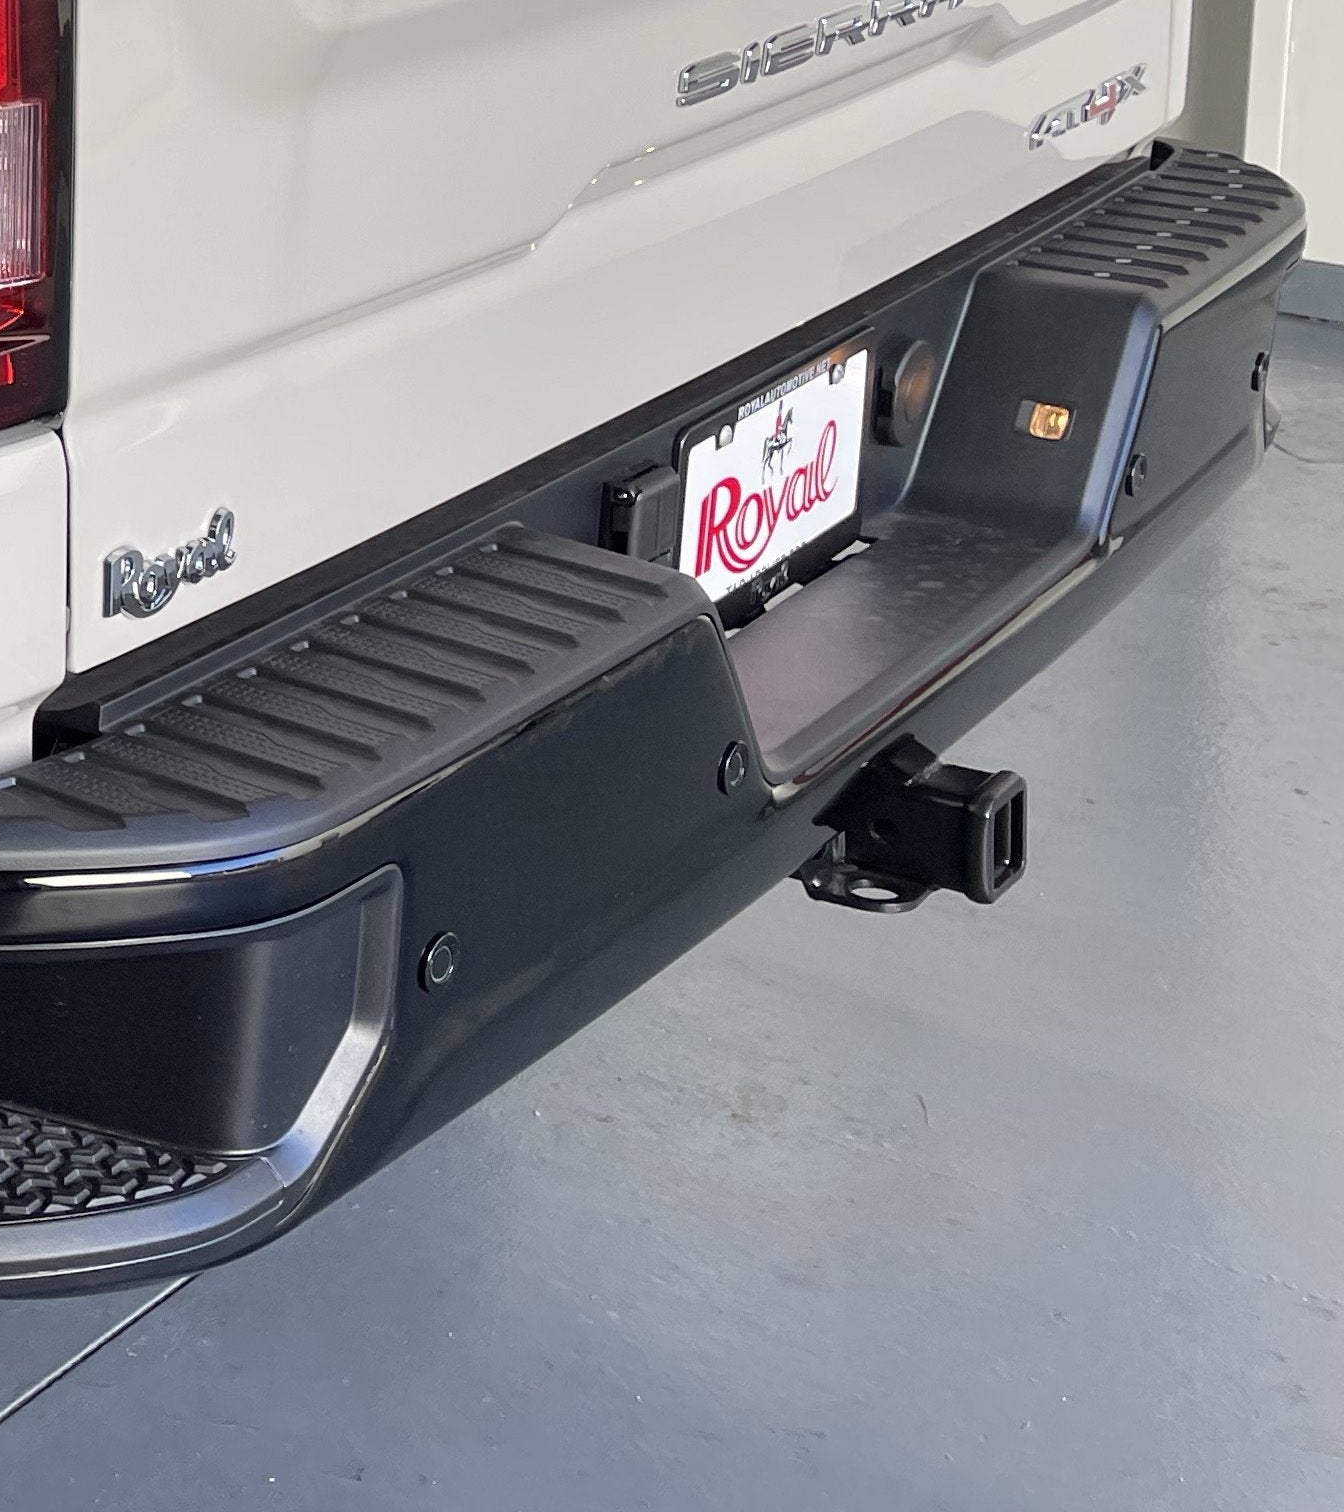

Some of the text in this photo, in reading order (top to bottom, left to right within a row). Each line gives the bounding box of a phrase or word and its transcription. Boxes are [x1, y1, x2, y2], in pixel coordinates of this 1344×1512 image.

[1028, 62, 1148, 151] AT4X
[737, 356, 832, 421] ROYALAUTOMOTIVE.NET
[694, 419, 840, 579] Royal
[102, 506, 237, 619] Royal
